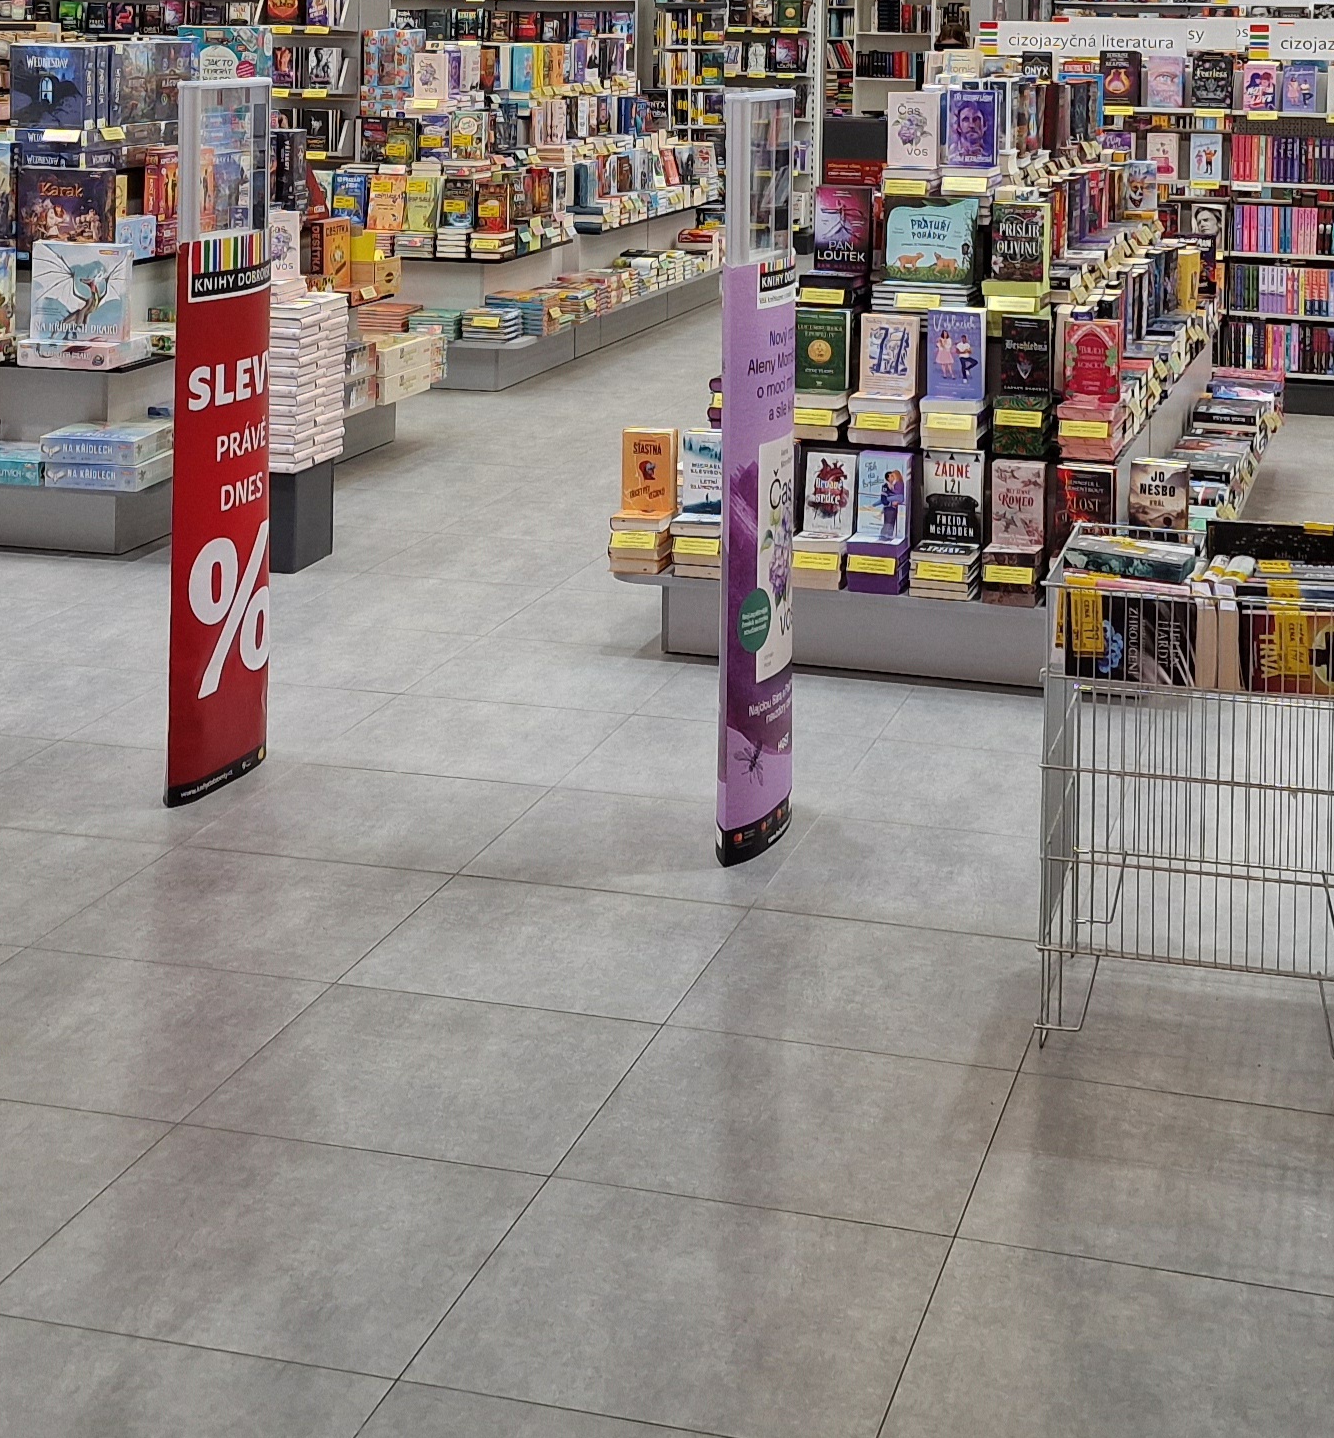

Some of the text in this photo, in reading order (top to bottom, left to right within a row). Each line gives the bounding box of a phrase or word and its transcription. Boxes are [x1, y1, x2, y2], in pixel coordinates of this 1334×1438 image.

[1008, 32, 1174, 51] cizojazyčná literatura
[26, 55, 69, 68] WEDNESDAY
[1024, 65, 1049, 76] ONYX
[897, 102, 921, 116] Čas
[39, 182, 83, 199] Karak
[817, 250, 866, 263] LOUTEK
[194, 266, 235, 293] KNIHY
[761, 272, 784, 289] KNIHY
[769, 326, 788, 347] Nový
[748, 355, 776, 377] Aleny
[216, 414, 267, 462] PRÁVĚ
[63, 442, 113, 455] NA KŘÍDLECH
[67, 468, 117, 481] NA KŘÍDLECH
[935, 460, 971, 479] ŽÁDNÉ
[1150, 470, 1165, 483] JO
[220, 471, 263, 512] DNES
[768, 469, 792, 511] Čas
[944, 479, 961, 494] LŽI
[1139, 482, 1176, 498] NESBØ
[998, 492, 1034, 509] ROMEO
[936, 514, 967, 526] FREIDA
[929, 523, 974, 538] McFADDEN
